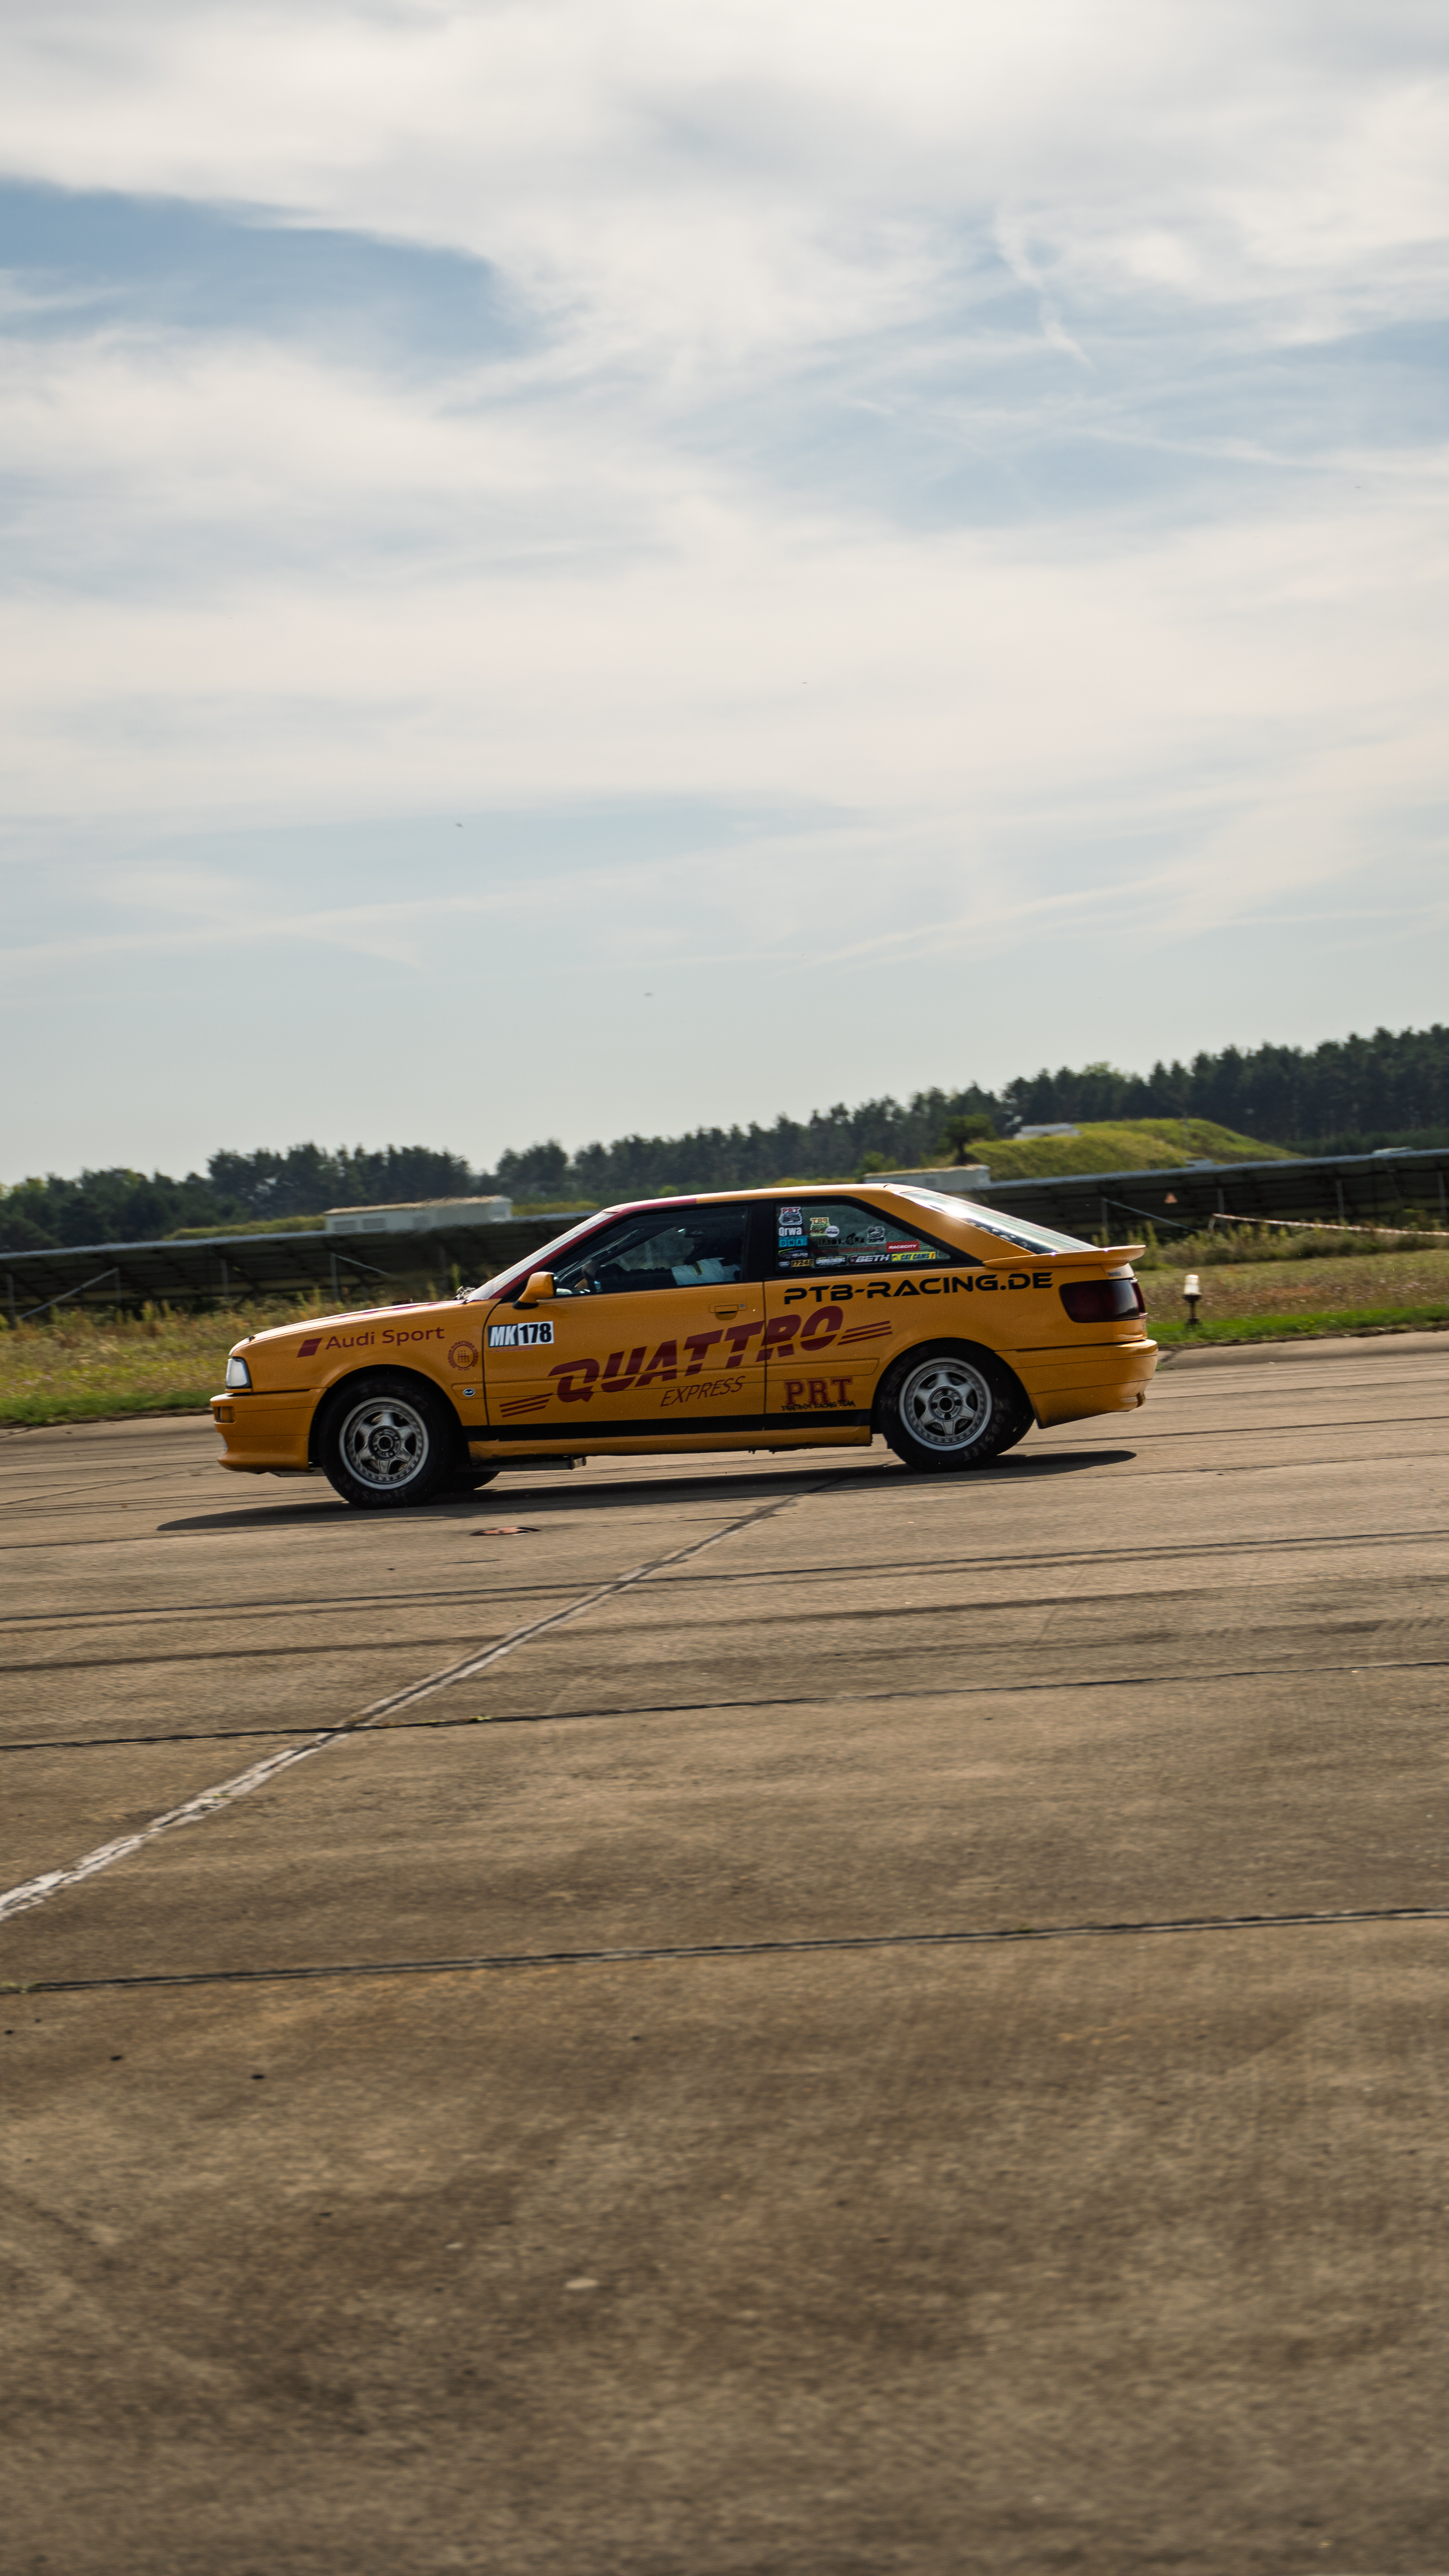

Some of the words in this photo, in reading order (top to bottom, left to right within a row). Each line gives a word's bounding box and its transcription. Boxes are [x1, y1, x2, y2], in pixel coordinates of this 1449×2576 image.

[855, 1254, 890, 1263] BETH
[784, 1272, 1053, 1305] PTB-RACING.DE
[325, 1331, 375, 1350] Audi
[382, 1327, 445, 1346] Sport
[547, 1306, 844, 1403] QUATTRO
[660, 1375, 746, 1407] EXPRESS
[784, 1377, 853, 1406] PRT
